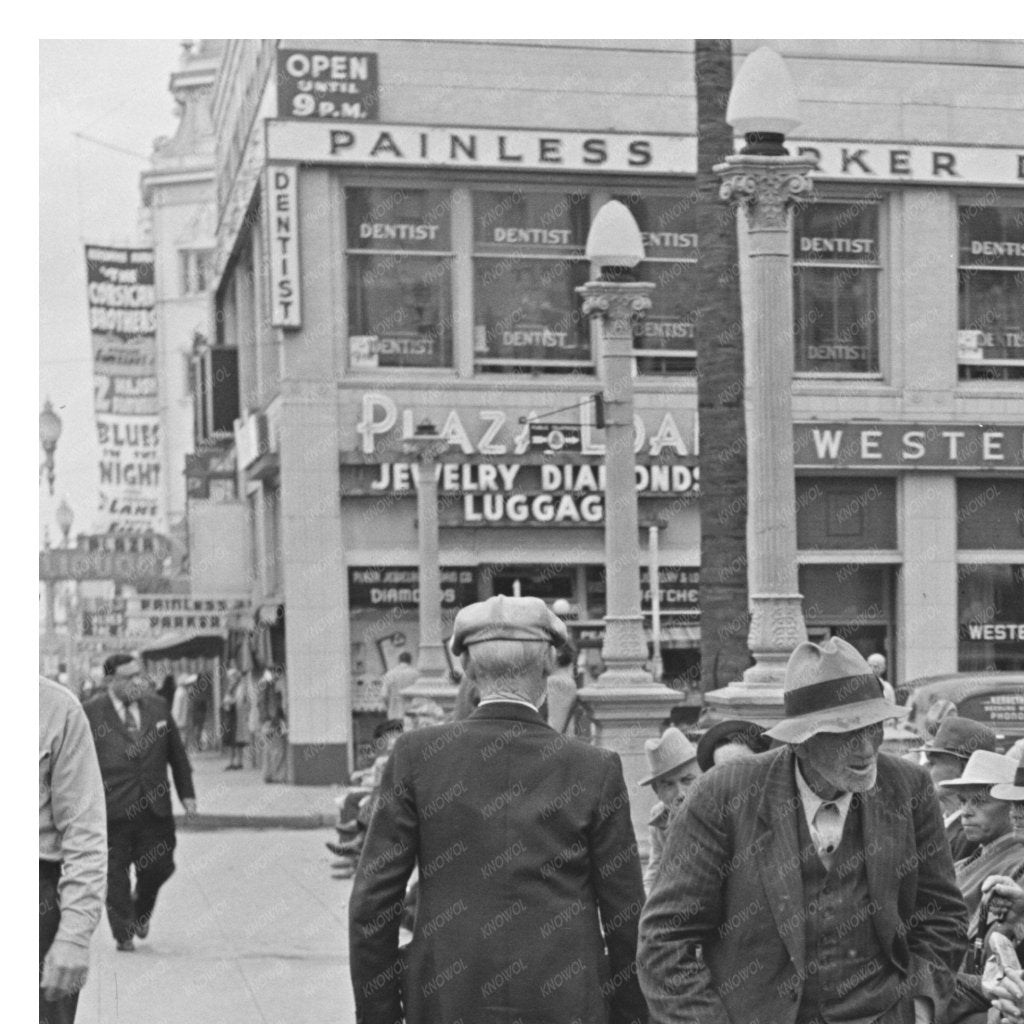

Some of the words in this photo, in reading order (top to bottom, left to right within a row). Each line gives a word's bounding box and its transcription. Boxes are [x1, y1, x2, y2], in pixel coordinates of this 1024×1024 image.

[285, 53, 368, 80] OPEN
[297, 80, 359, 94] UNTIL
[292, 92, 315, 117] 9
[318, 101, 368, 118] P.M.
[329, 129, 654, 167] PAINLESS
[782, 146, 961, 177] RKER
[359, 223, 439, 240] DENTIST
[493, 227, 572, 244] DENTIST
[275, 172, 294, 319] DENTIST
[801, 236, 875, 253] DENTIST
[502, 331, 567, 348] DENTIST
[807, 345, 868, 361] DENTIST
[97, 421, 160, 447] BLUES
[100, 460, 161, 486] NIGHT
[464, 494, 603, 522] LUGGAG
[370, 587, 456, 604] DIAMOS
[140, 600, 227, 611] PAINLESS
[149, 616, 221, 628] PARKER
